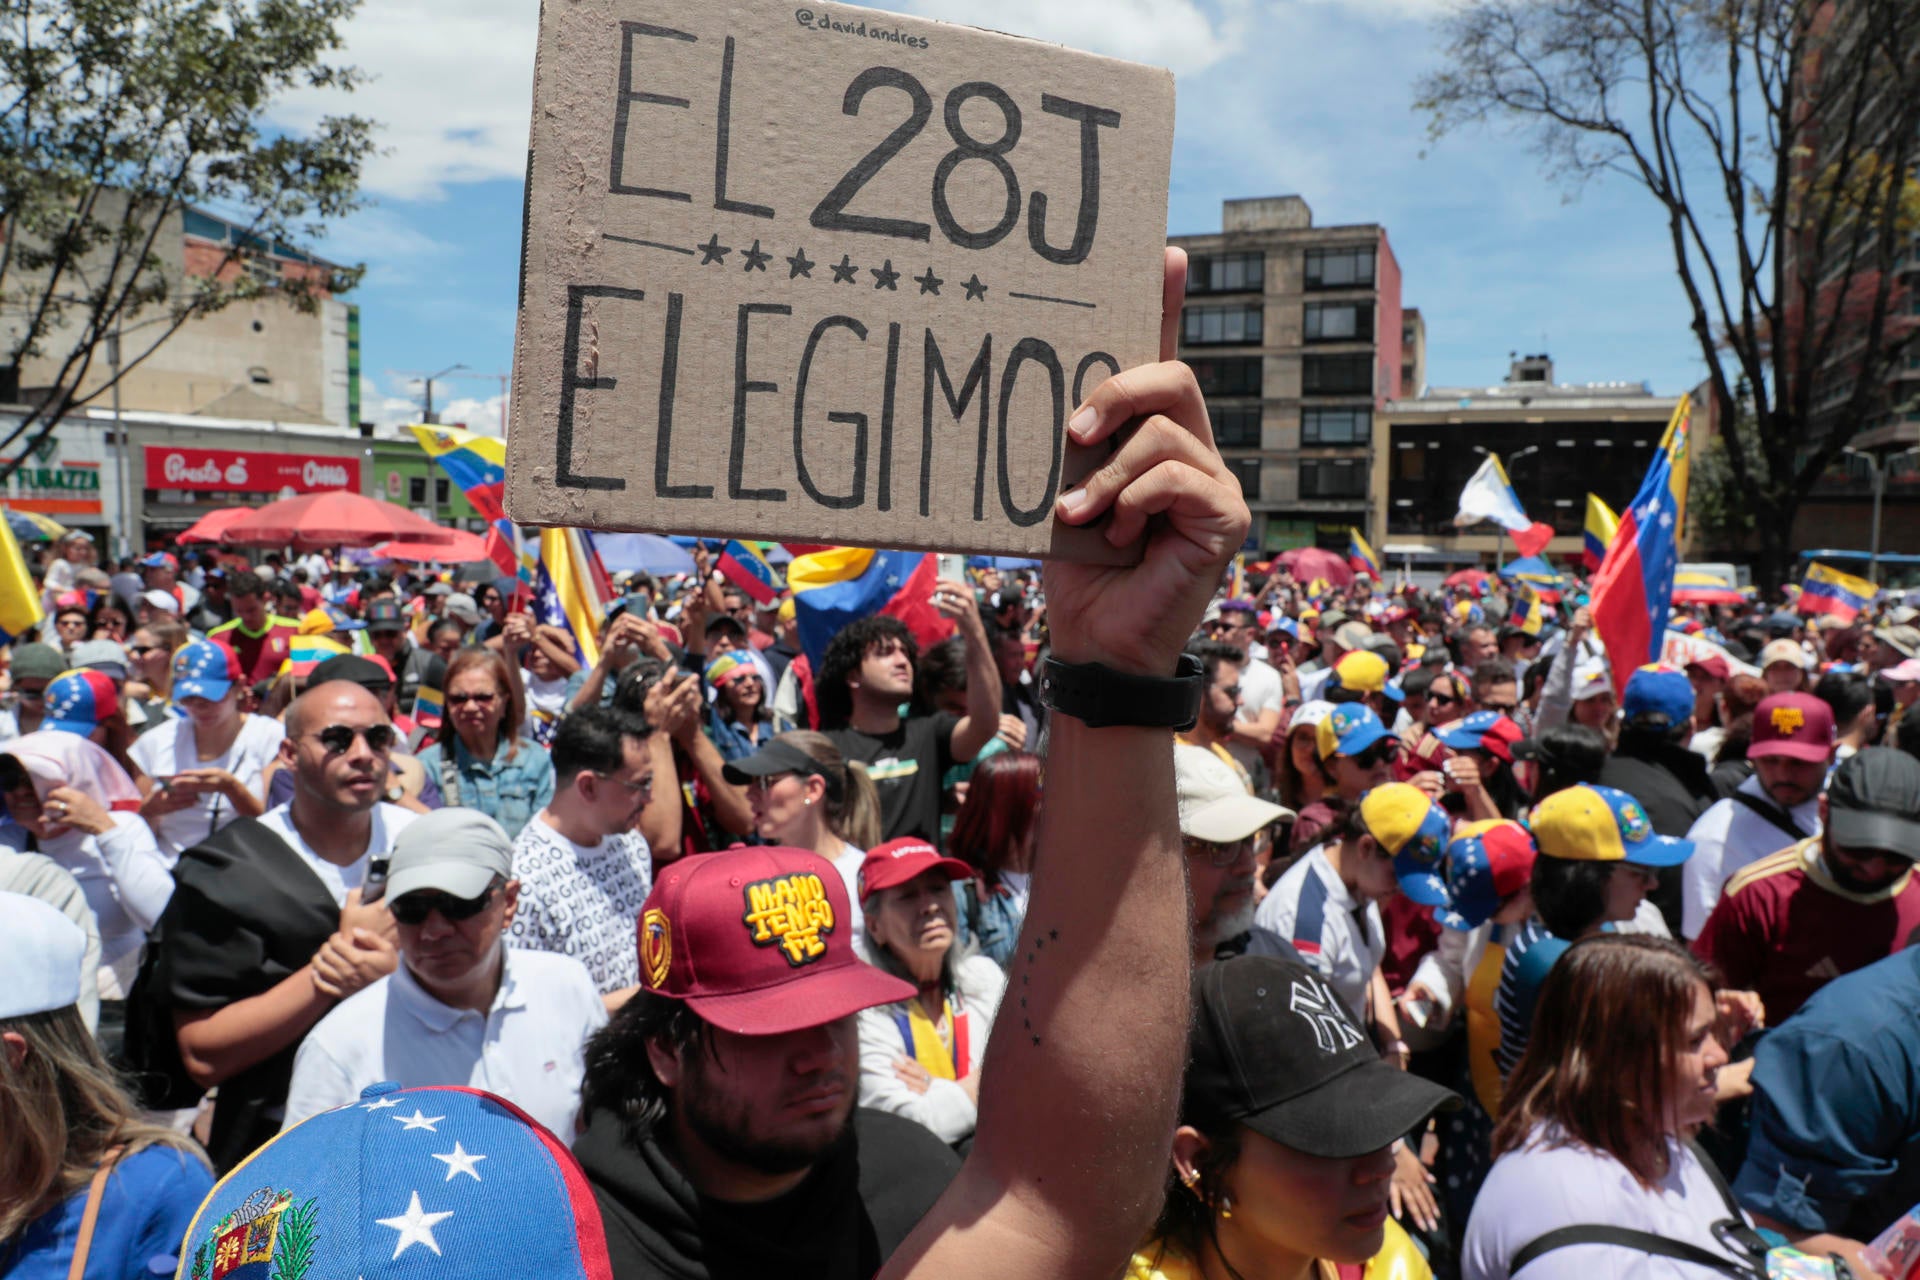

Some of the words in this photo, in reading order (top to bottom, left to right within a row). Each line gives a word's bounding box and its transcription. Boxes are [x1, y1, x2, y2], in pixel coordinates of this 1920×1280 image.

[609, 21, 775, 219] EL
[810, 66, 1121, 265] 28J
[749, 874, 825, 914] MANO
[745, 899, 835, 941] TENGO
[782, 926, 826, 962] FE
